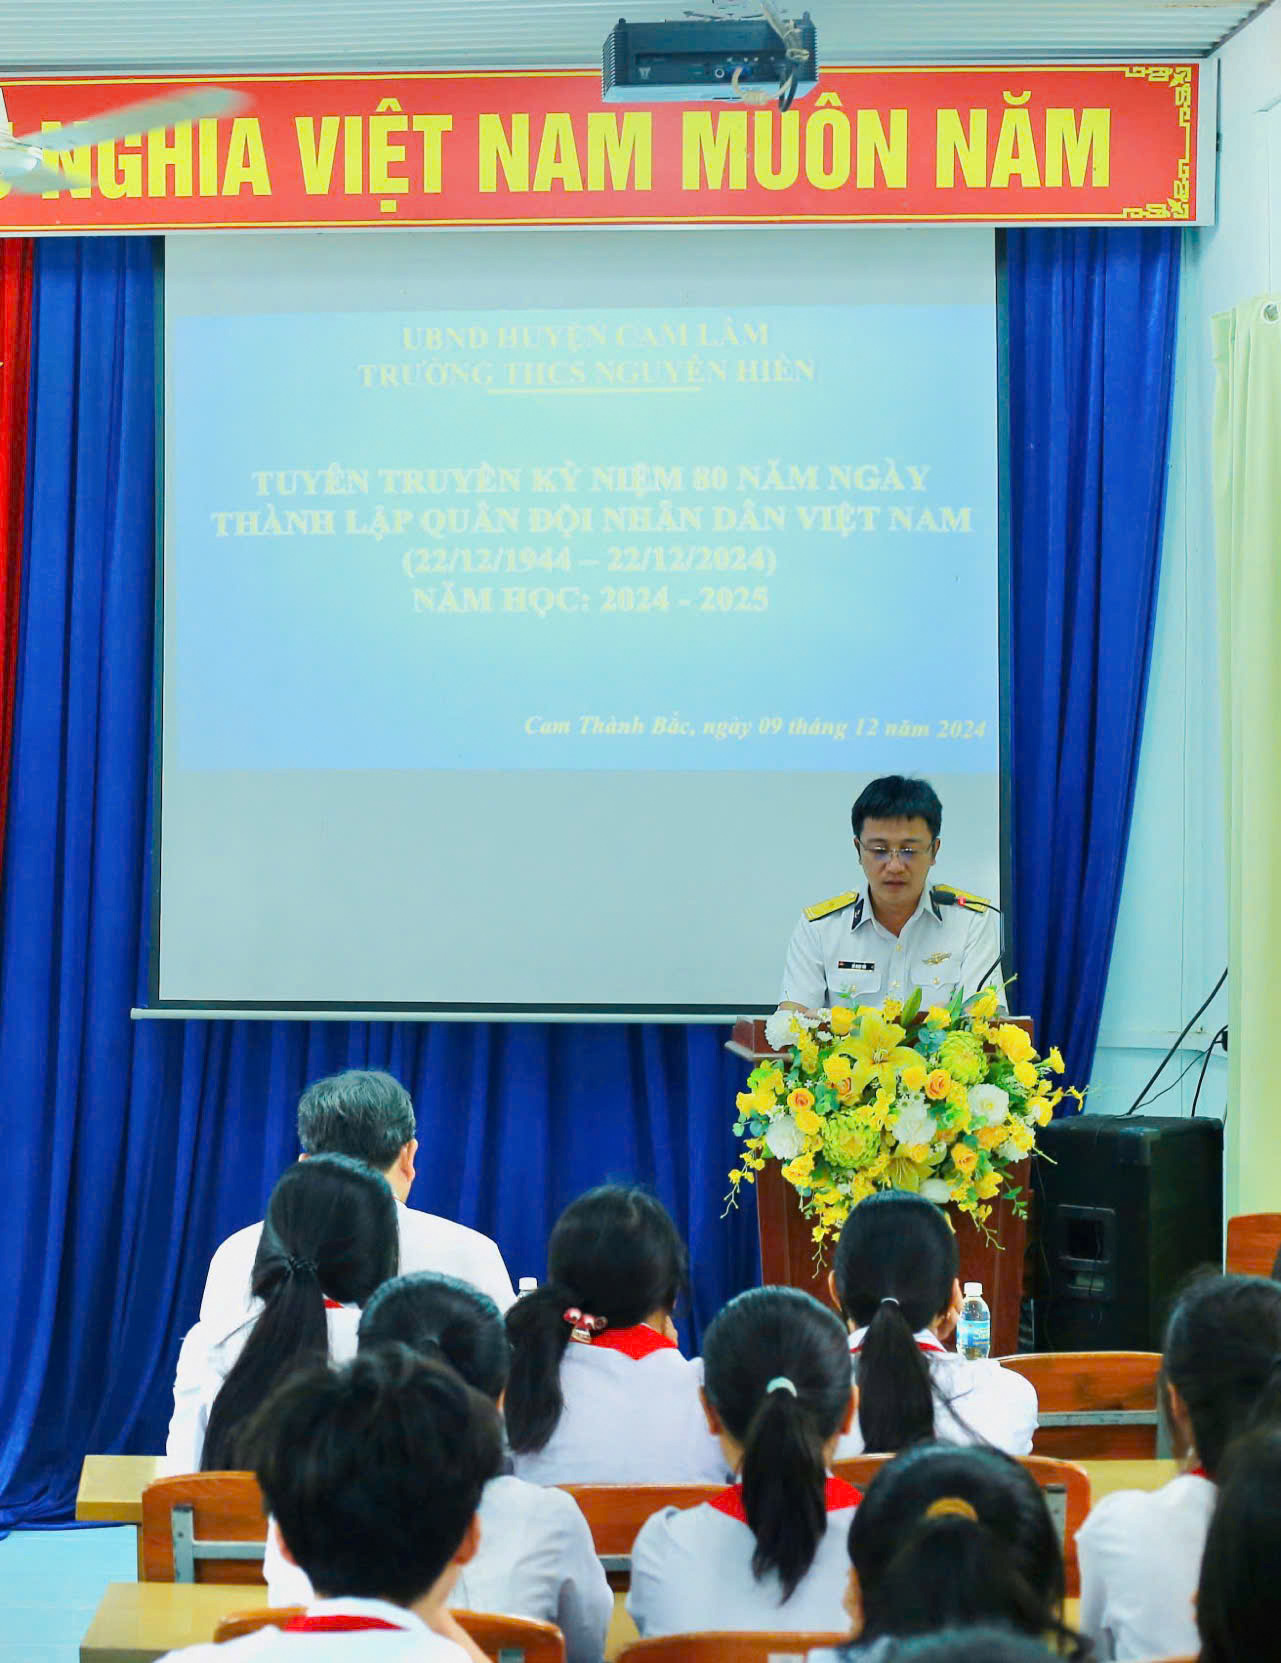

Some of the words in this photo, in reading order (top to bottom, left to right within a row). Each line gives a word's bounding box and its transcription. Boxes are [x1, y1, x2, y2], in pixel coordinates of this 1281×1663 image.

[294, 97, 454, 213] VIỆT
[478, 112, 653, 194] NAM
[681, 92, 908, 192] MUÔN
[935, 90, 1112, 189] NĂM
[402, 324, 489, 352] UBND
[616, 321, 689, 348] CAM
[504, 359, 586, 386] THCS
[251, 461, 369, 497] TUYÊN
[591, 461, 683, 497] NIỆM
[692, 465, 728, 492] 80
[736, 458, 820, 493] NĂM
[827, 457, 932, 493] NGÀY
[210, 503, 336, 538] THÀNH
[345, 504, 414, 542] LẬP
[420, 500, 521, 539] QUÂN
[528, 503, 593, 539] ĐỘI
[602, 500, 705, 533] NHÂN
[711, 498, 787, 533] DÂN
[796, 500, 883, 538] VIỆT
[888, 506, 974, 535] NAM
[401, 546, 572, 578] (22/12/1944
[607, 545, 777, 577] 22/12/2024)
[411, 581, 494, 614] NĂM
[503, 586, 591, 619] HỌC:
[599, 585, 671, 613] 2024
[699, 585, 770, 613] 2025
[524, 714, 572, 736] Cam
[578, 714, 645, 736] Thành
[703, 716, 753, 741] ngày
[758, 716, 784, 736] 09
[788, 716, 849, 741] tháng
[856, 716, 879, 738] 12
[885, 719, 930, 739] năm
[936, 719, 988, 740] 2024
